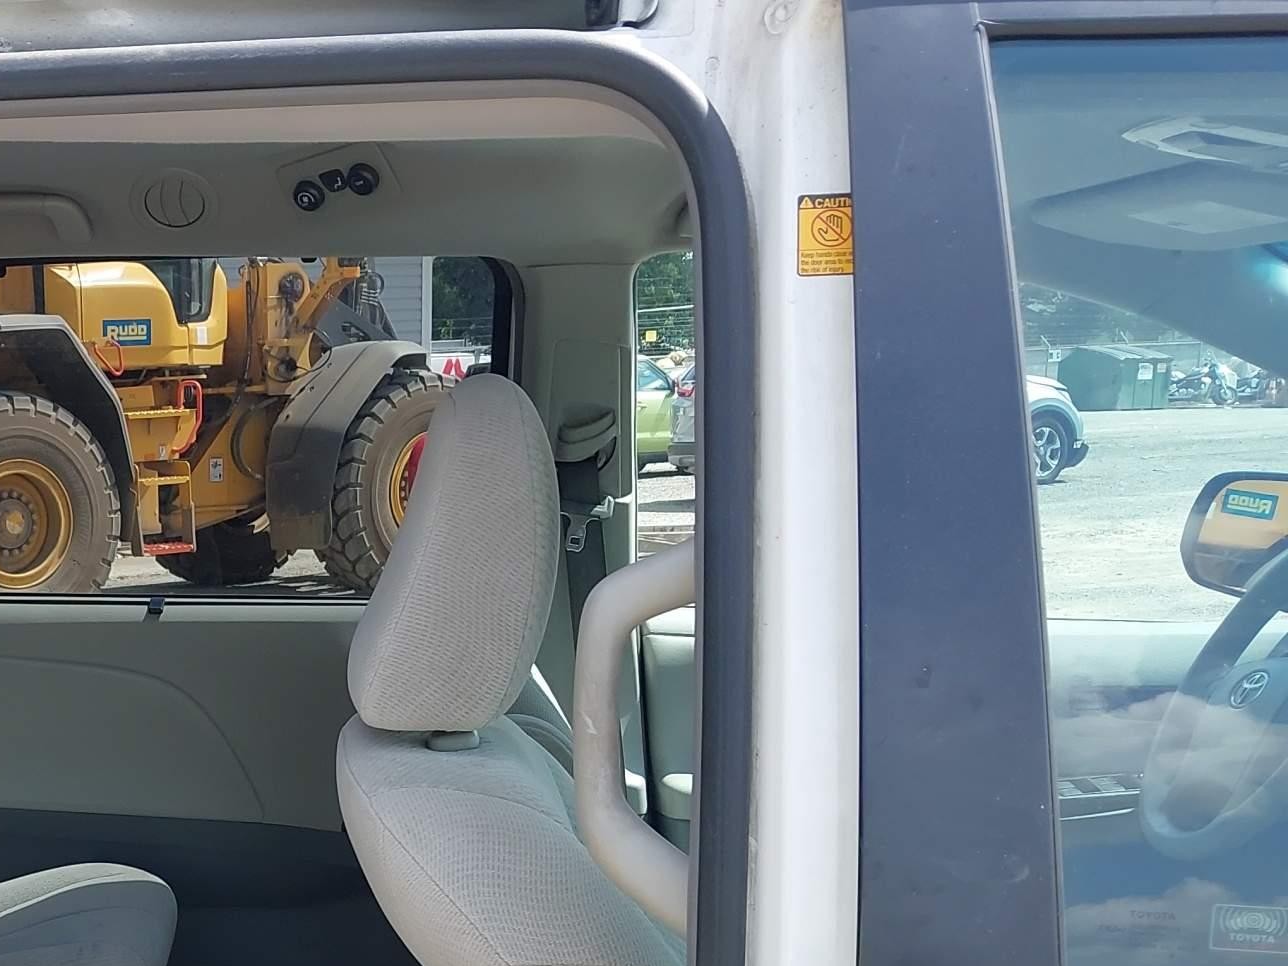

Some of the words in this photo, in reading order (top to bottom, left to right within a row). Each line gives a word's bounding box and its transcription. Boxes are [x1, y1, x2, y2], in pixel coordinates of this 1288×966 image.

[815, 198, 852, 208] CAUTI
[107, 324, 147, 340] RUDD
[1229, 933, 1275, 943] TOYOTA
